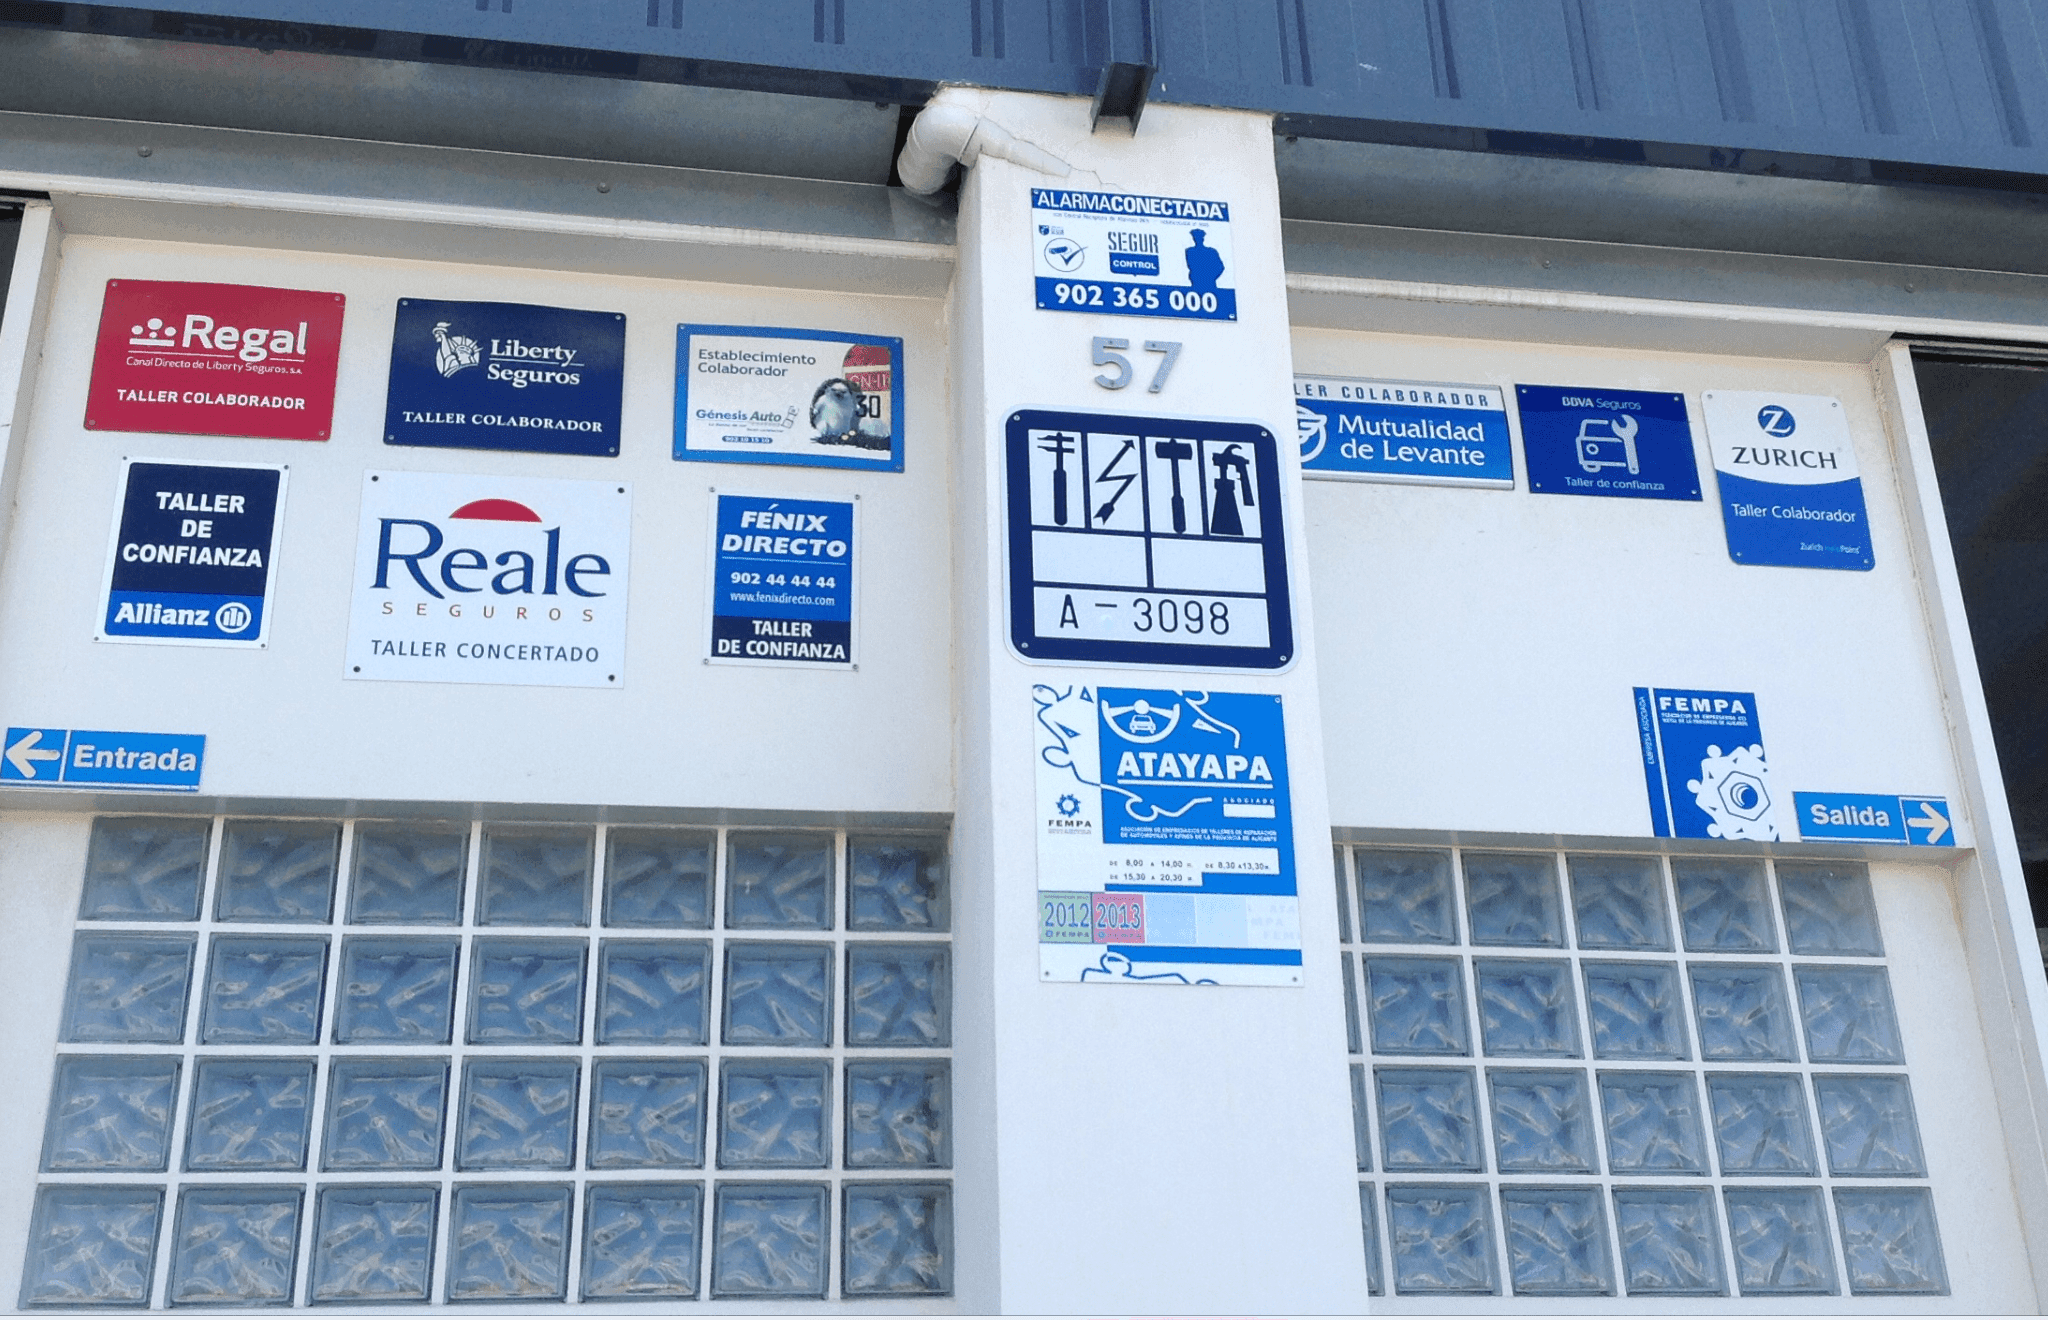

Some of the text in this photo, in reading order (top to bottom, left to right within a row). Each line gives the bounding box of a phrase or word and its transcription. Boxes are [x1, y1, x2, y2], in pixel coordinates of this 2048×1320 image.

[1107, 231, 1159, 254] SEGUR
[1112, 259, 1157, 270] CONTROL
[1054, 283, 1218, 313] 902 365 000
[182, 314, 307, 361] Regal
[491, 339, 577, 367] Liberty
[698, 349, 816, 366] Establecimiento
[126, 356, 153, 367] Canal
[155, 357, 191, 369] Directo
[192, 359, 205, 369] de
[206, 360, 243, 373] Liberty
[698, 363, 788, 377] Colaborador
[1092, 336, 1183, 393] 57
[487, 364, 580, 388] Seguros
[117, 389, 305, 410] TALLER COLABORADOR
[1342, 386, 1488, 406] COLABORADOR
[1562, 397, 1641, 411] BBVA Seguros
[403, 411, 602, 432] TALLER COLABORADOR
[696, 409, 782, 422] Génesis Auto
[1338, 414, 1485, 442] Mutualidad
[1340, 439, 1485, 466] de Levante
[1732, 446, 1838, 470] ZURICH
[1564, 476, 1665, 490] Taller de confianza
[156, 491, 245, 513] TALLER
[1731, 503, 1856, 523] Taller Colaborador
[180, 519, 213, 538] DE
[740, 503, 828, 533] FÉNIX
[122, 543, 262, 568] CONFIANZA
[722, 533, 847, 558] DIRECTO
[369, 517, 611, 600] Reale
[730, 571, 836, 589] 902 44 44 44
[729, 591, 836, 606] www.fenixdirecto.com
[114, 602, 210, 626] Allianz
[382, 602, 593, 622] SEGUROS
[1133, 597, 1229, 635] 3098
[752, 620, 812, 637] TALLER
[371, 639, 600, 663] TALLER CONCERTADO
[718, 639, 846, 660] DE CONFIANZA
[1659, 696, 1747, 714] FEMPA
[74, 744, 197, 772] Entrada
[1117, 751, 1273, 781] ATAYAPA
[1048, 819, 1092, 828] FEMPA
[1810, 804, 1891, 828] Salida
[1044, 901, 1140, 929] 2012 2013
